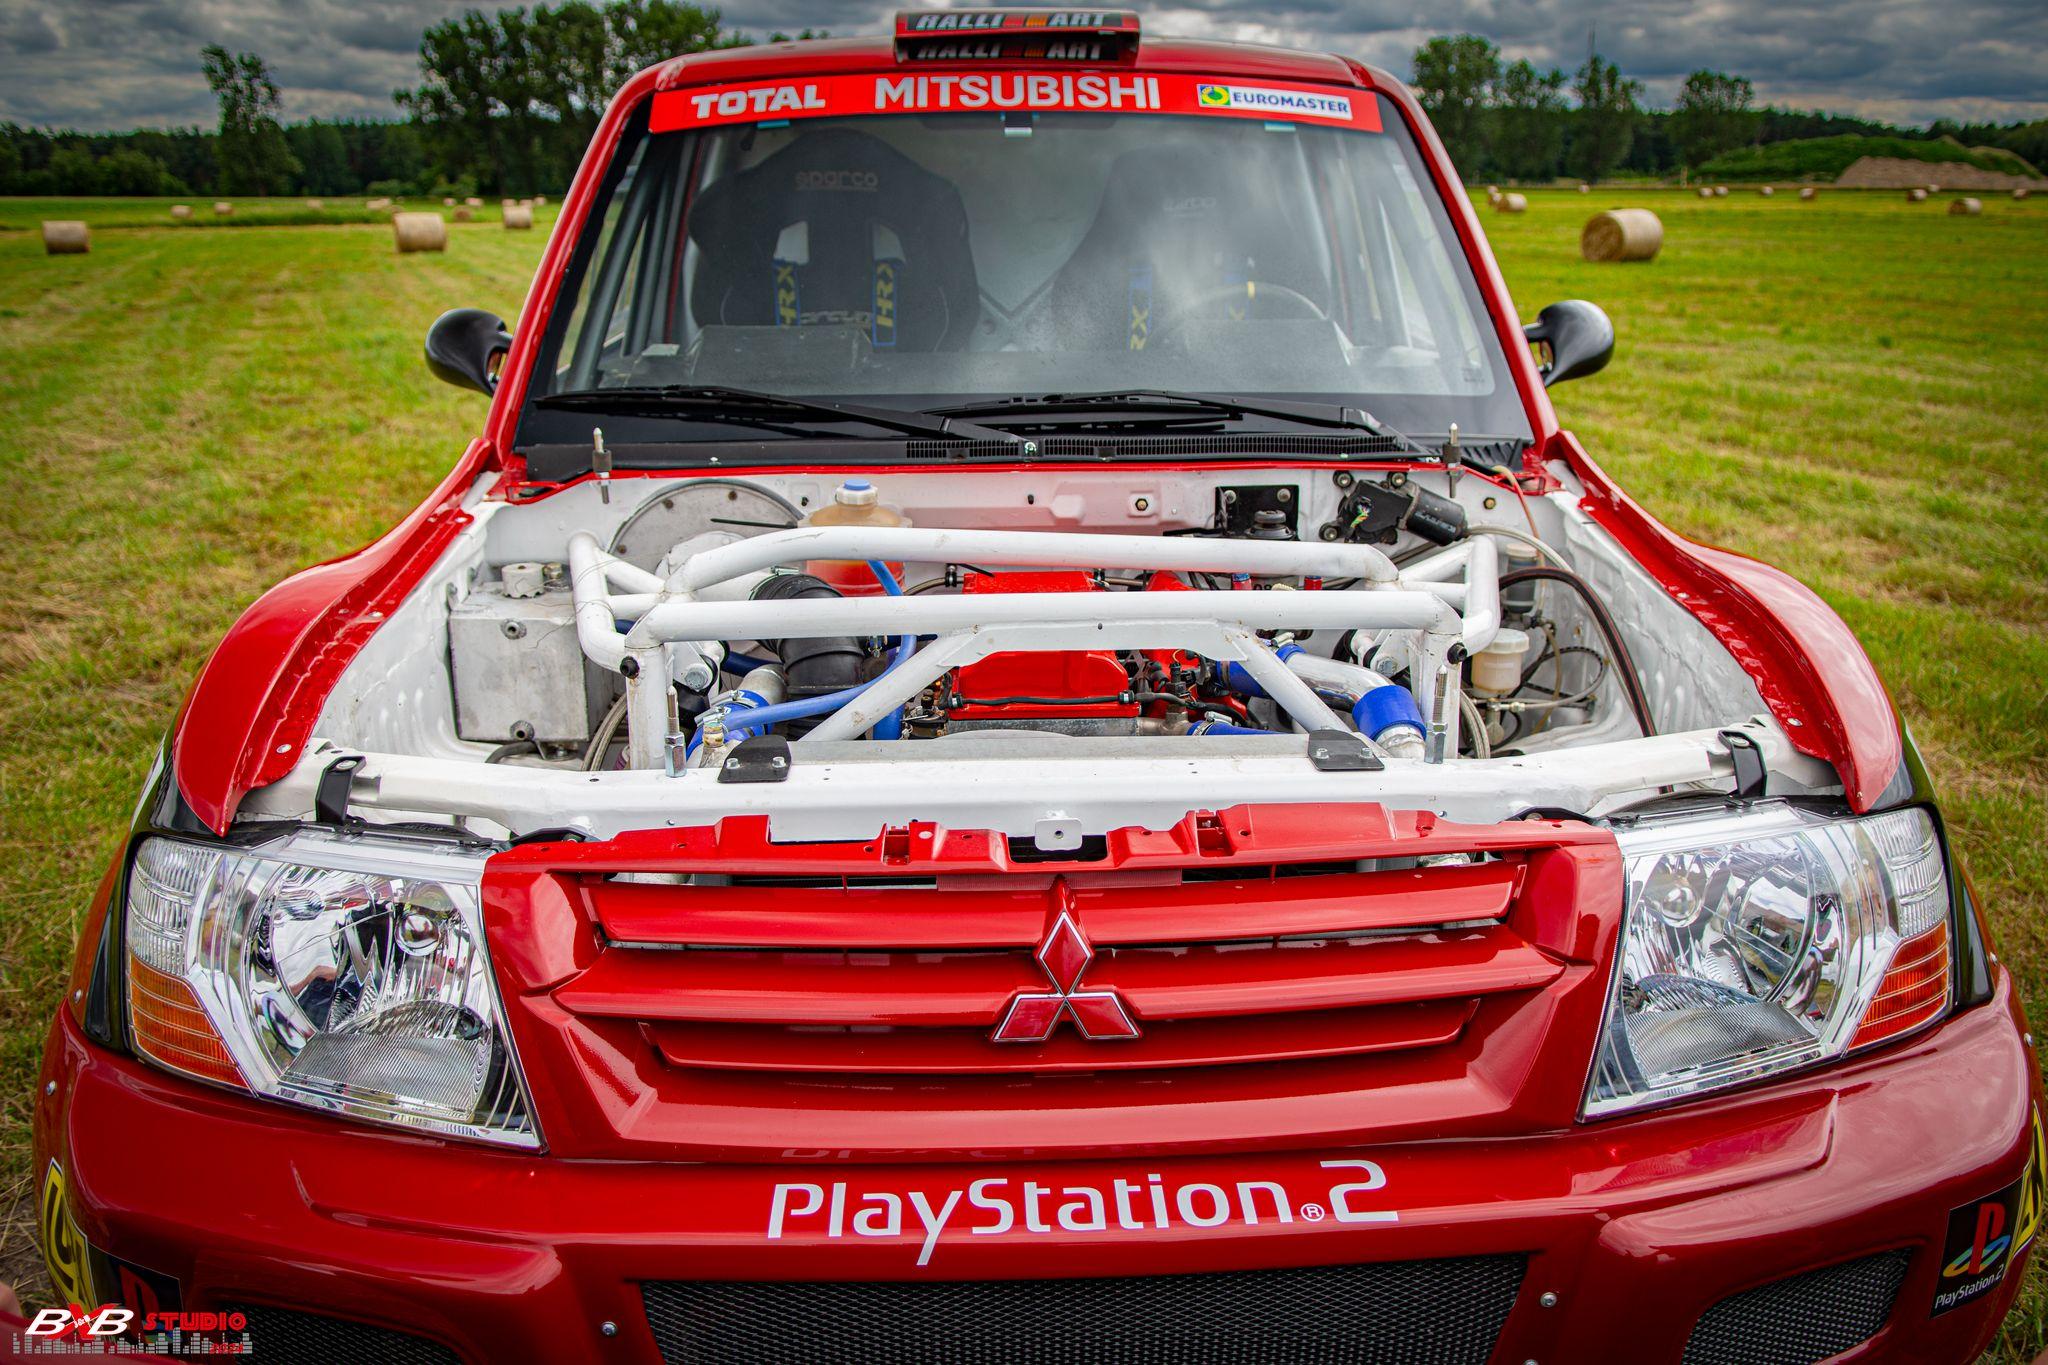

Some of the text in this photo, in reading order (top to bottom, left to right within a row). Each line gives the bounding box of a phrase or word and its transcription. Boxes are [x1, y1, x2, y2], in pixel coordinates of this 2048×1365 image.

[915, 12, 1112, 30] RALLI ART
[691, 84, 826, 119] TOTAL
[874, 75, 1161, 110] MITSUBISHI
[1231, 91, 1349, 113] EUROMASTER
[1934, 1274, 1995, 1310] PlayStation
